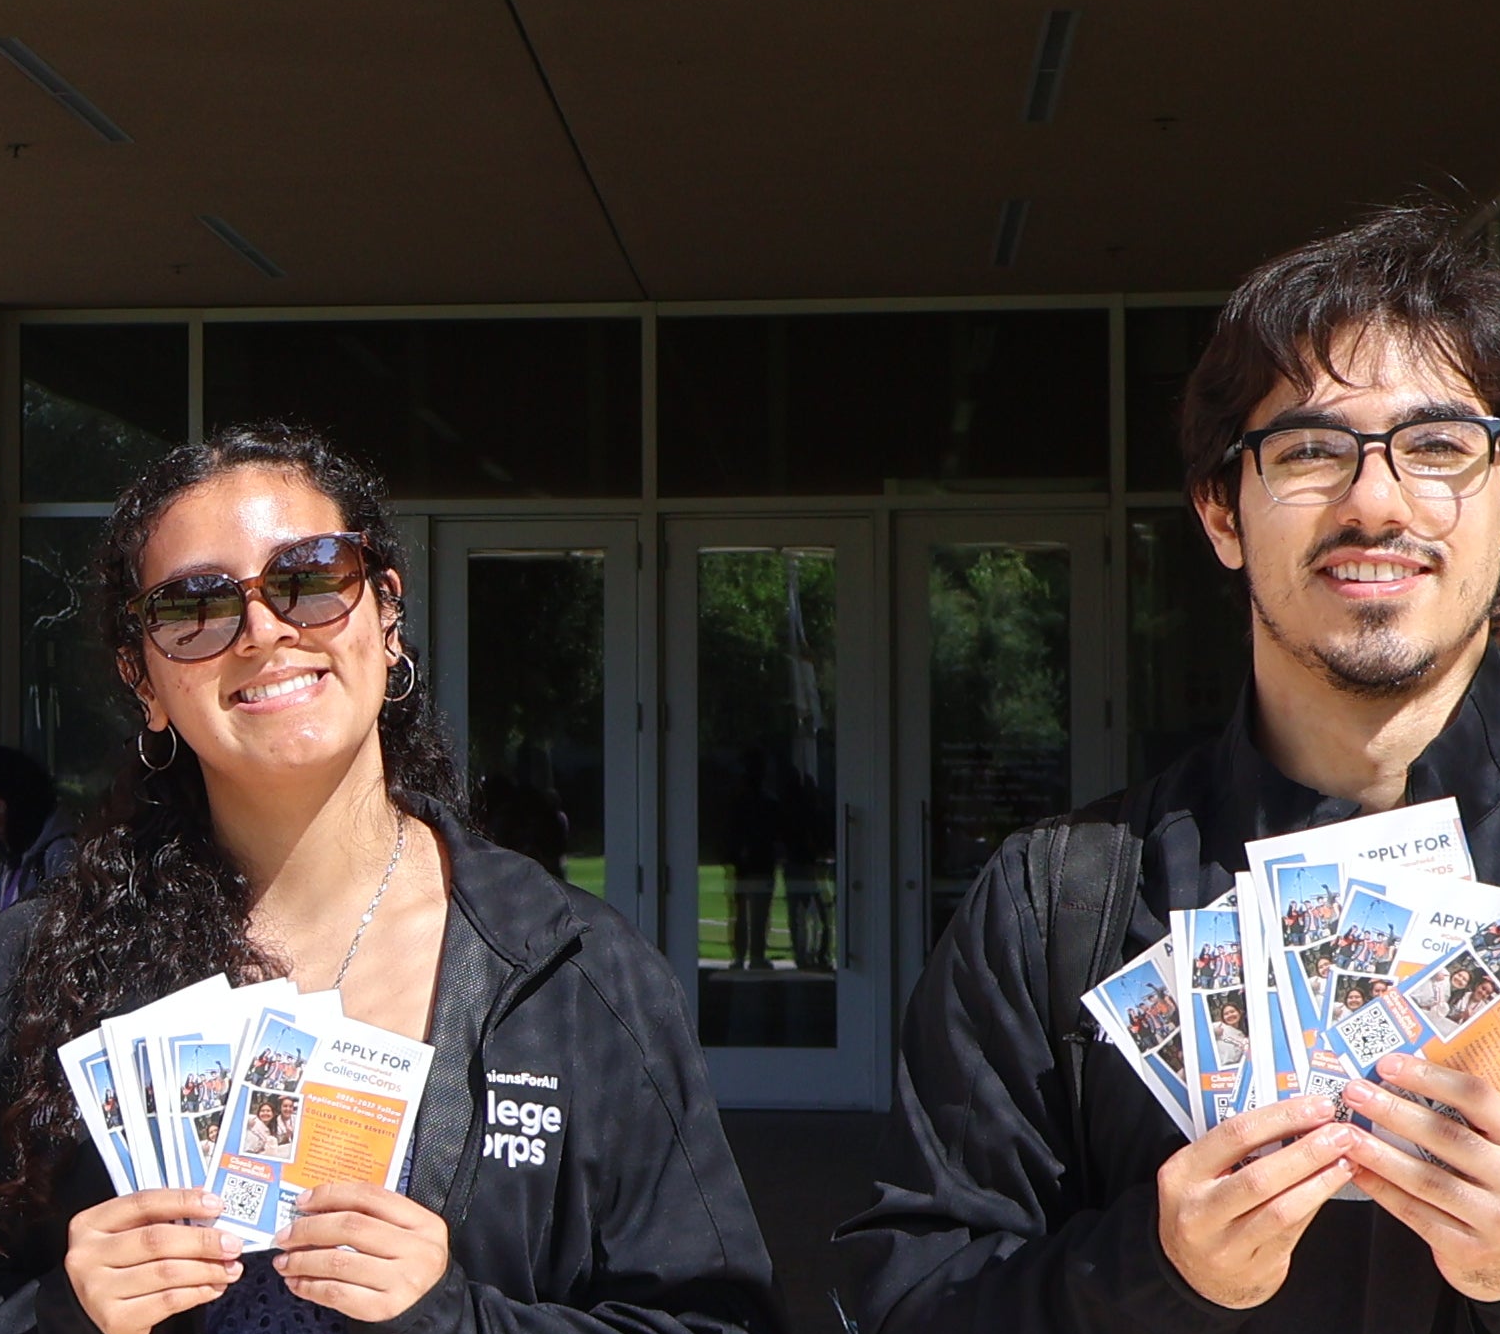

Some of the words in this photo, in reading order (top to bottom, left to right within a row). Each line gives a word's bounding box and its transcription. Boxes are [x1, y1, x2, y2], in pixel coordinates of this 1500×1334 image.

[1414, 834, 1452, 854] FOR
[331, 1039, 377, 1060] APPLY
[381, 1054, 410, 1071] FOR
[324, 1061, 400, 1092] CollegeCorps
[487, 1090, 561, 1136] lege
